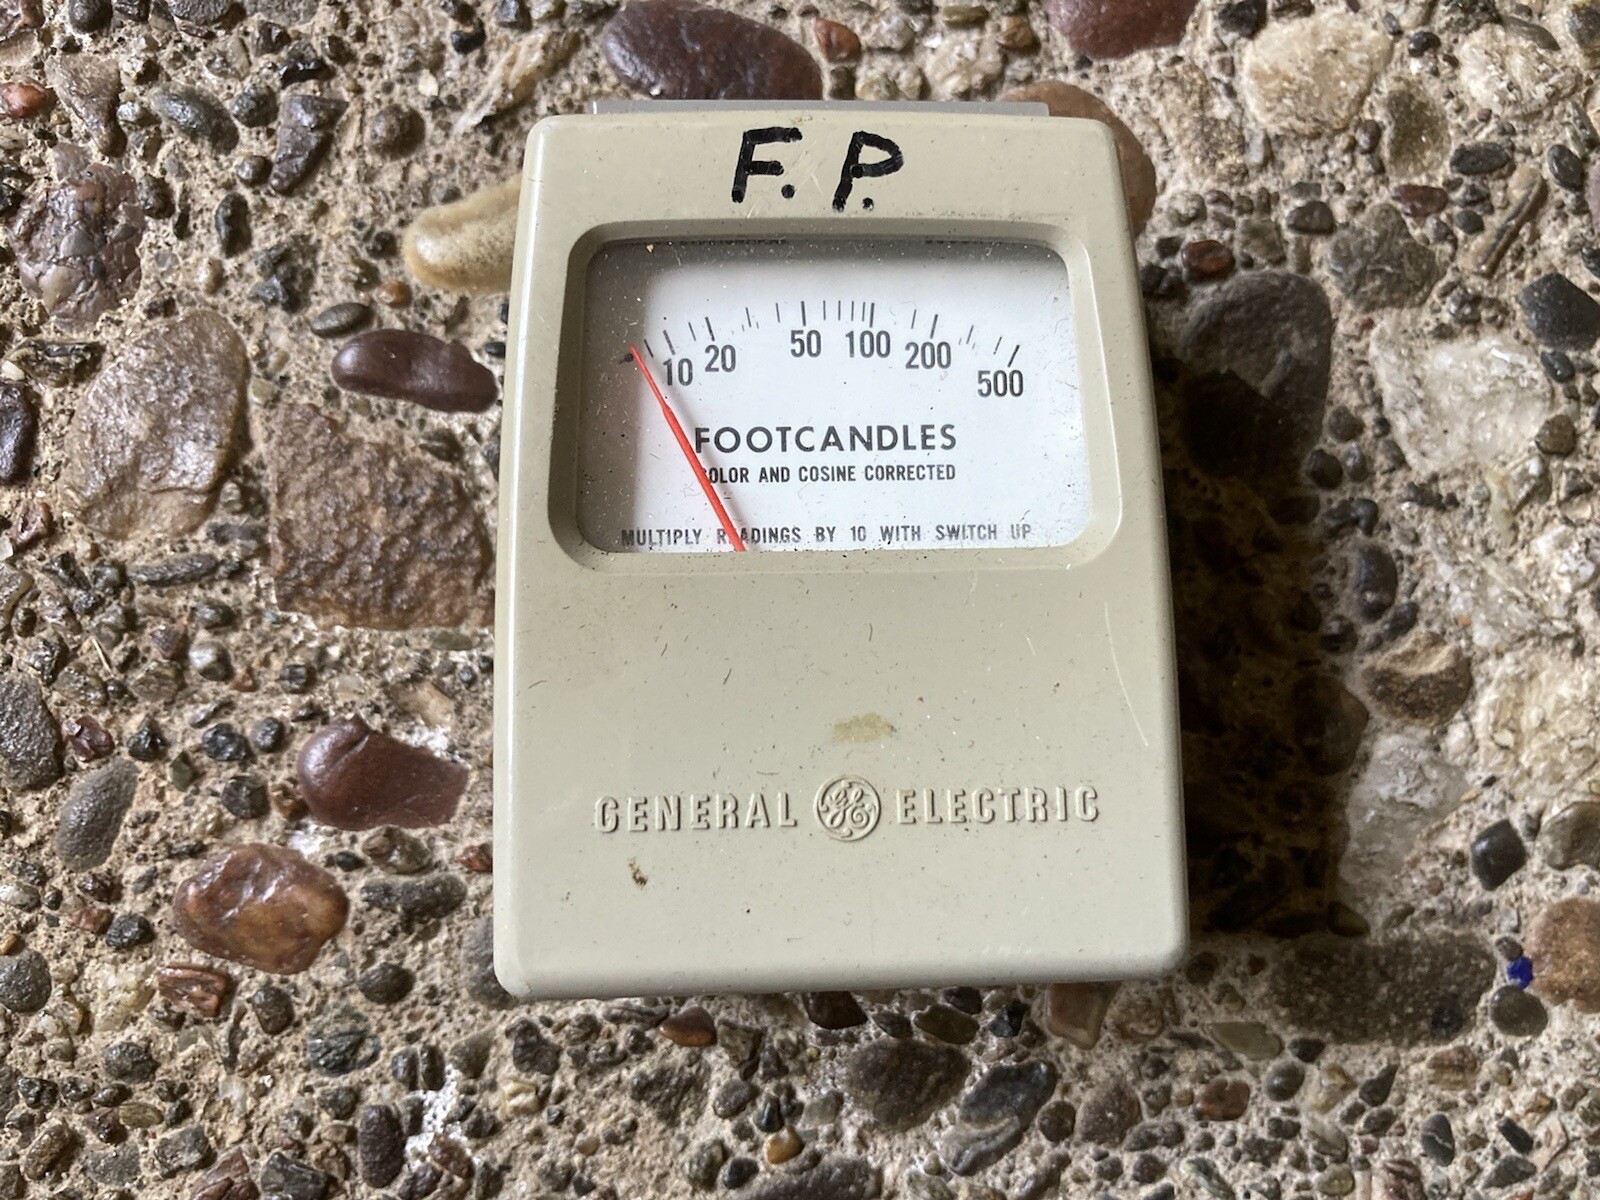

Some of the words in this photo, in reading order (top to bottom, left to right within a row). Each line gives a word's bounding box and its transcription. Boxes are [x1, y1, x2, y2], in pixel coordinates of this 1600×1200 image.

[663, 358, 693, 386] 10
[705, 344, 736, 373] 20
[790, 329, 822, 358] 50
[845, 330, 891, 358] 100
[905, 341, 951, 370] 200
[977, 370, 1024, 398] 500
[695, 424, 956, 454] FOOTCANDLES
[759, 467, 790, 482] AND
[798, 465, 856, 482] COSINE
[864, 464, 956, 481] CORRECTED
[621, 528, 702, 546] MULTIPLY
[716, 527, 801, 545] RADINGS
[815, 526, 836, 542] BY
[850, 525, 866, 542] 10
[880, 525, 921, 542] WITH
[935, 523, 997, 541] SWITCH
[1010, 523, 1032, 540] UP
[594, 791, 798, 833] GENERAL
[896, 785, 1101, 825] ELECTRIC
